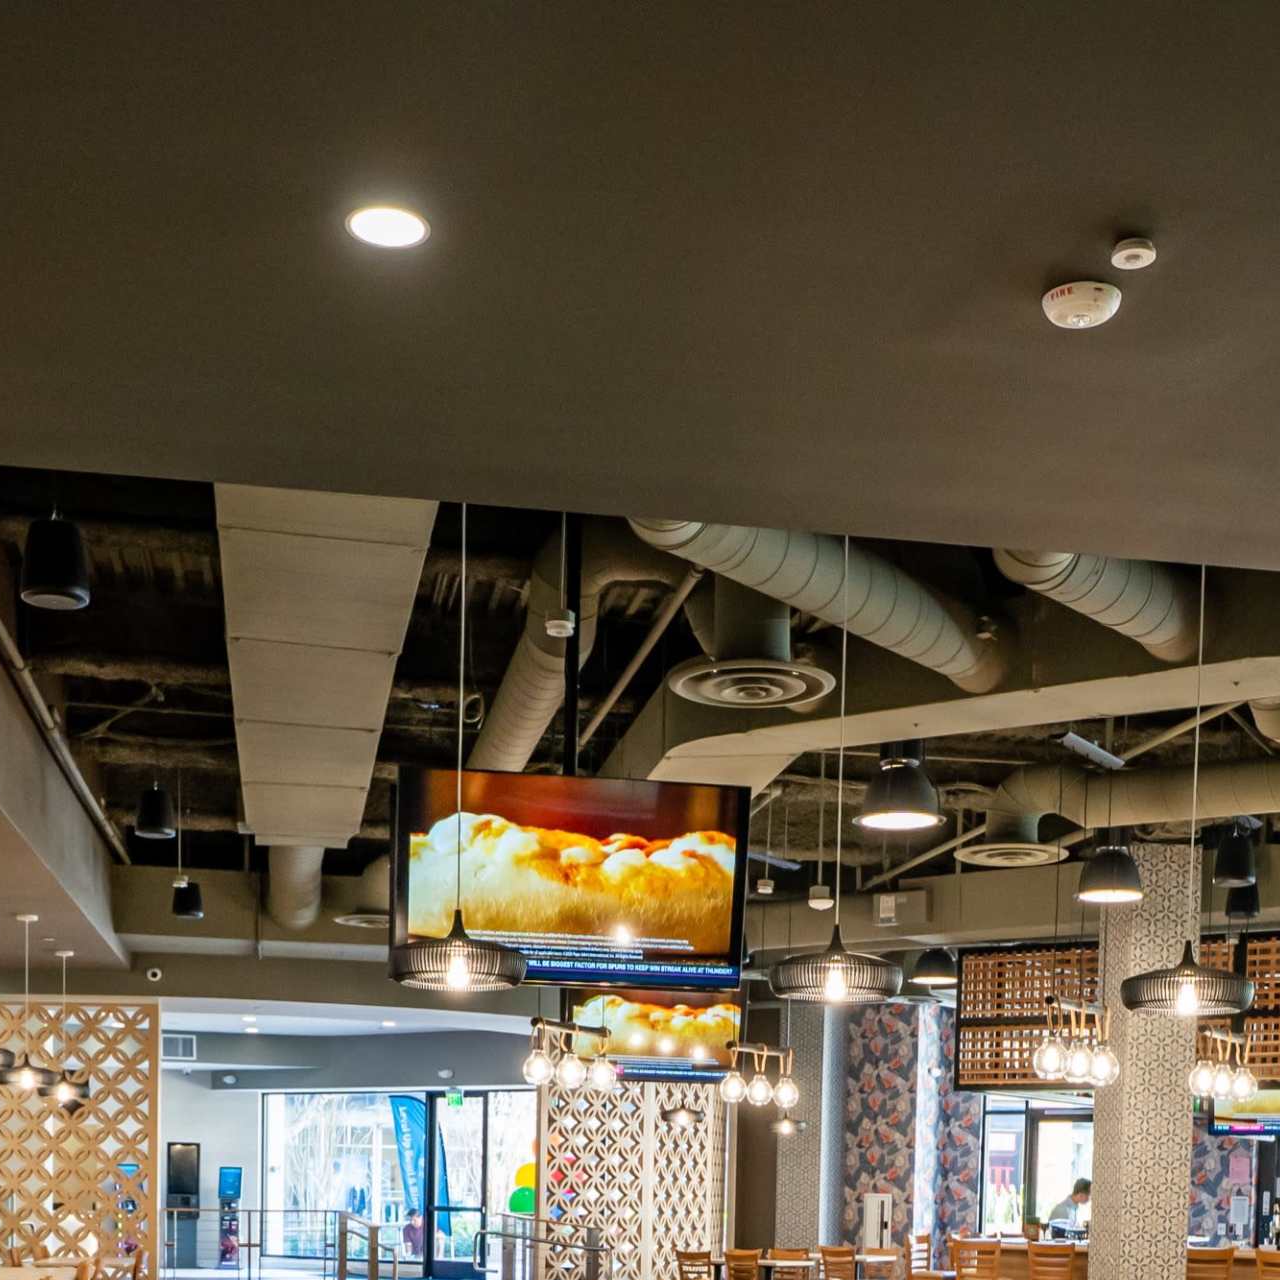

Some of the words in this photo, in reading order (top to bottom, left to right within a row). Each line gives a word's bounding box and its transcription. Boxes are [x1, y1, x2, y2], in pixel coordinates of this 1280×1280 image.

[1050, 286, 1072, 301] FIRE
[528, 959, 542, 967] WILL
[550, 960, 573, 968] BIGGEST
[574, 961, 595, 969] FACTOR
[608, 962, 626, 970] SPURS
[650, 964, 660, 972] WIN
[661, 965, 681, 973] STREAK
